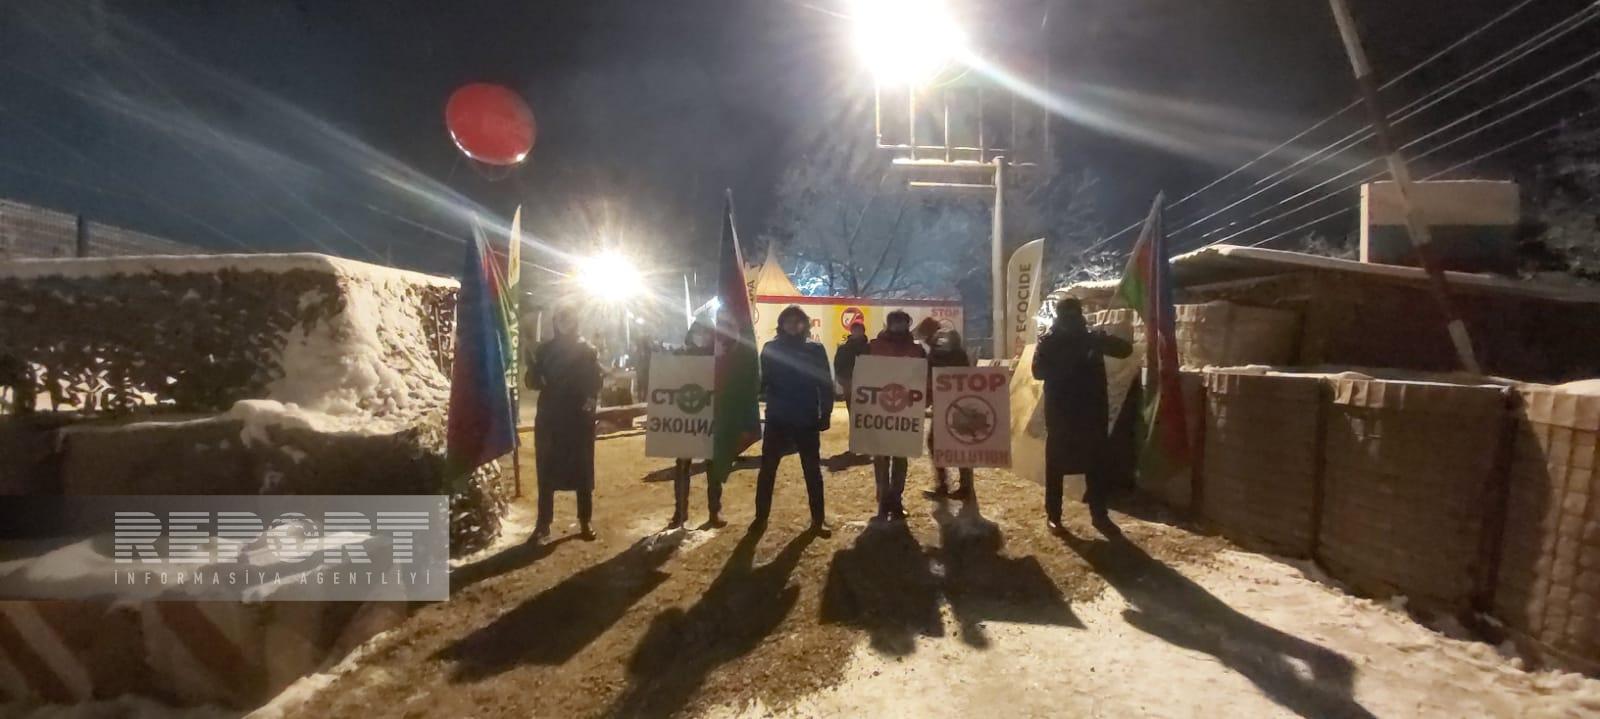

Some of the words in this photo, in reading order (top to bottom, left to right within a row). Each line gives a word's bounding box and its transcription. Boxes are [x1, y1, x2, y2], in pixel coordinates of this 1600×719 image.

[1016, 263, 1031, 333] ECOCIDE
[935, 373, 1006, 392] STOP
[855, 383, 923, 413] STOP
[854, 413, 919, 433] ECOCIDE
[934, 448, 1009, 465] POLLUTION
